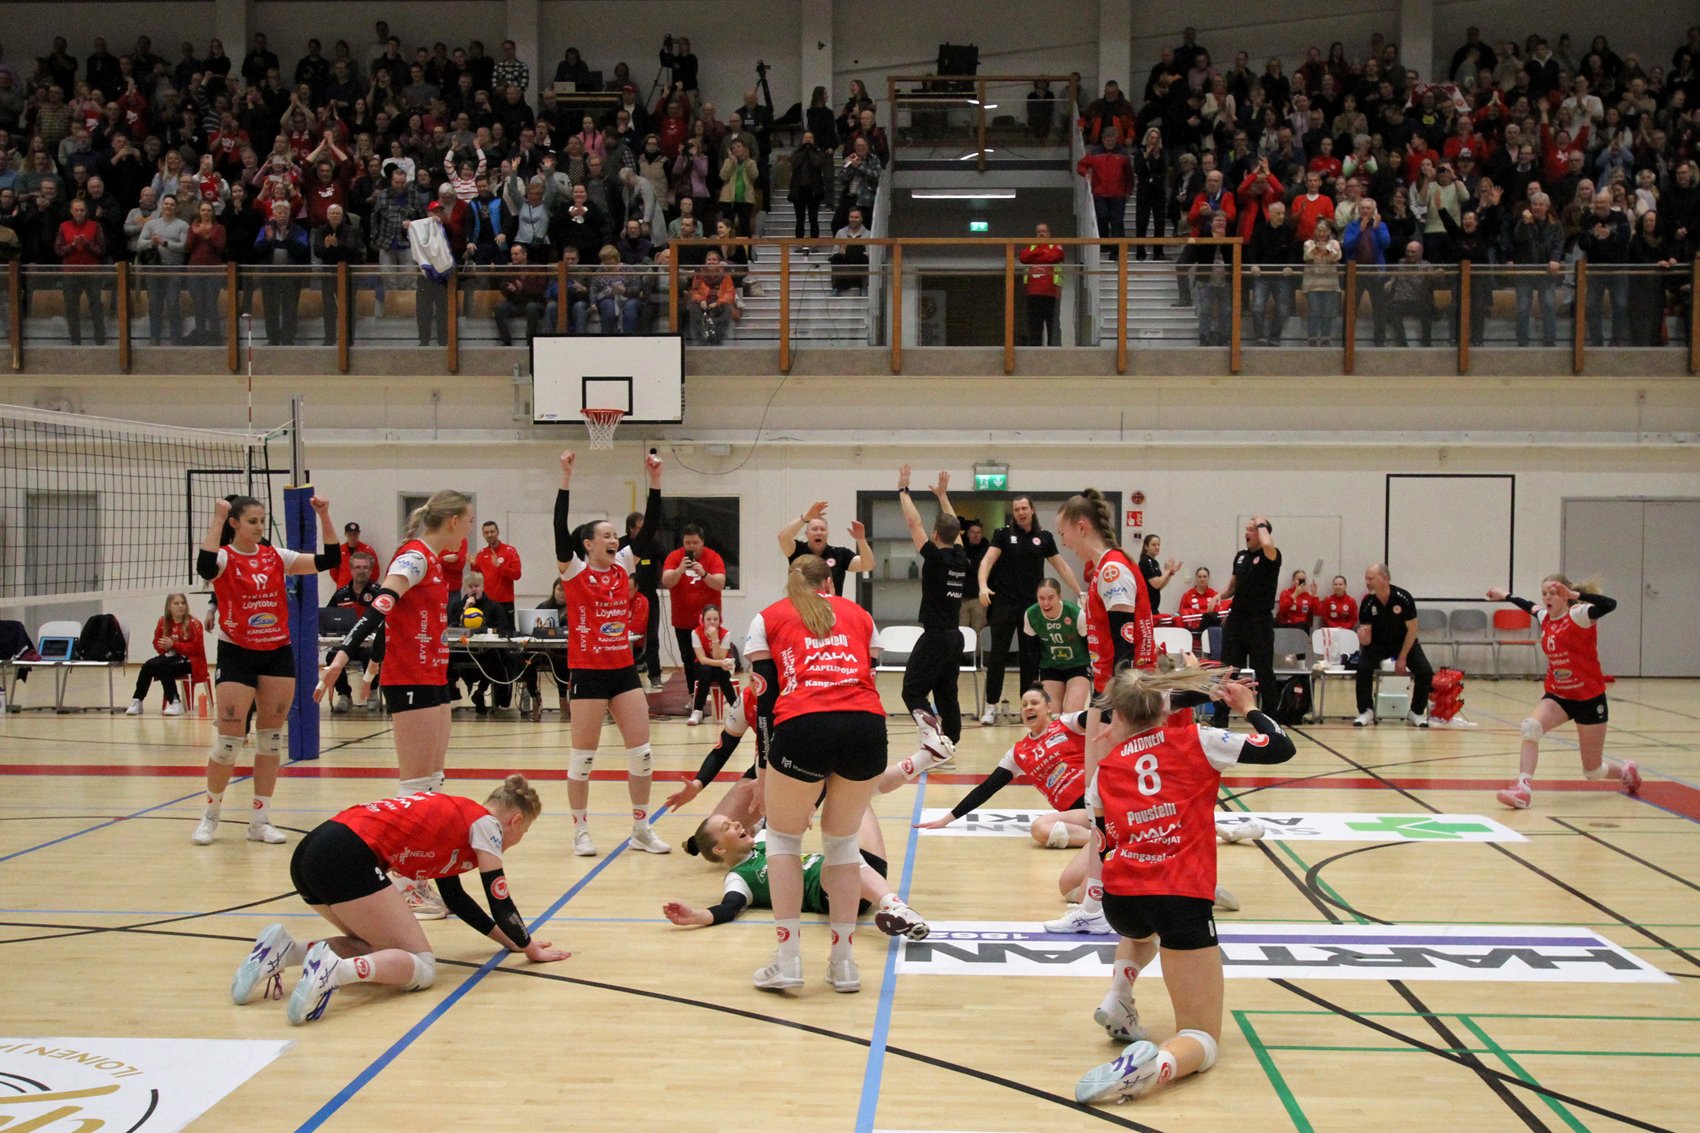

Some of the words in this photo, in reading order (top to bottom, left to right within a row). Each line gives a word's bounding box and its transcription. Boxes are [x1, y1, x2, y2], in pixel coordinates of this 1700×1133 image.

[251, 573, 268, 590] 19
[1121, 730, 1165, 757] JALONEN
[1134, 754, 1162, 796] 8
[1126, 802, 1177, 826] Puustelli
[905, 942, 1644, 970] HARTAN
[23, 1046, 144, 1079] ILOINEN
